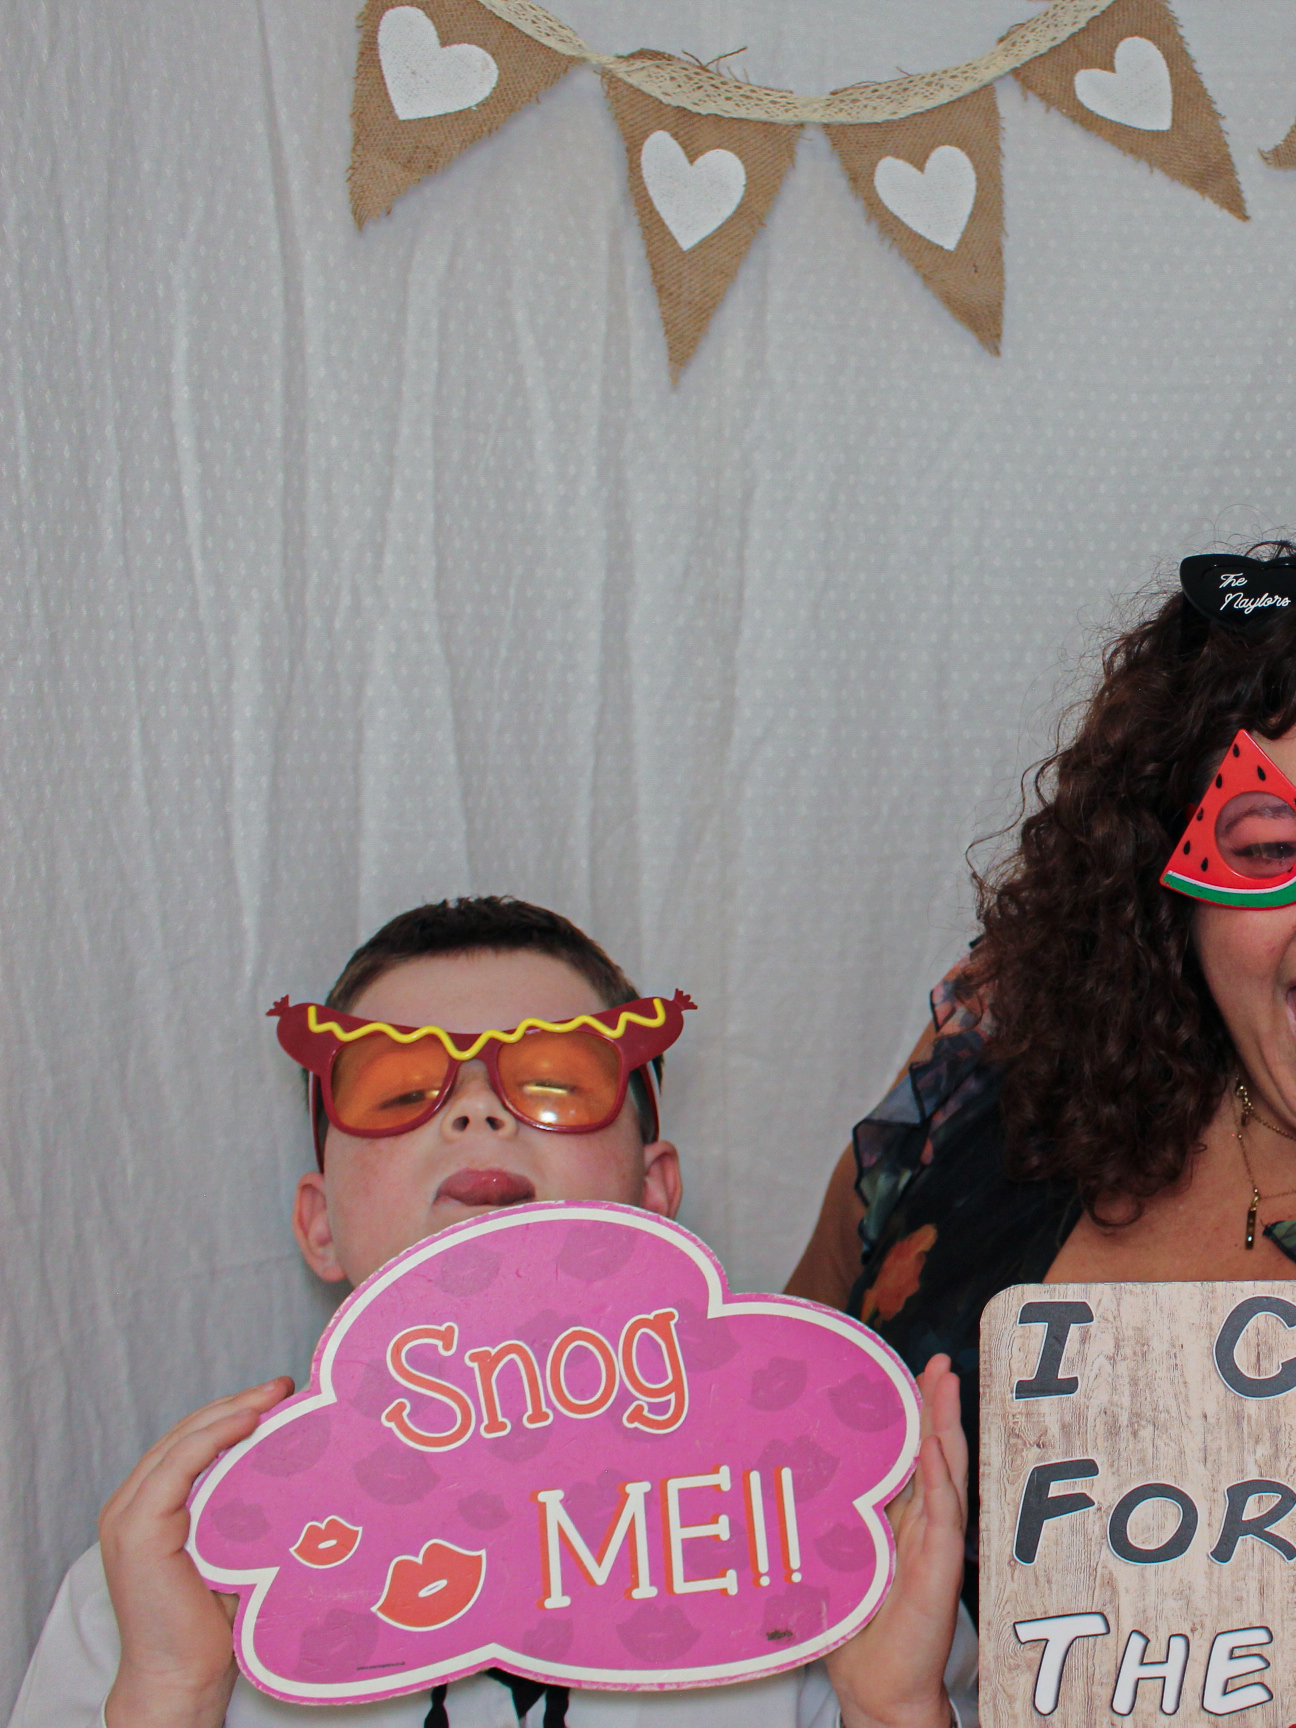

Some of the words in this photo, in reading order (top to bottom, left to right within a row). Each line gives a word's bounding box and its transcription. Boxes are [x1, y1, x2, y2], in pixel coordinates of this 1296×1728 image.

[1219, 573, 1248, 588] The
[1220, 592, 1291, 615] Naylors
[381, 1307, 688, 1452] Snog
[1012, 1301, 1095, 1402] I
[529, 1465, 802, 1610] ME!!
[1013, 1612, 1274, 1717] THE
